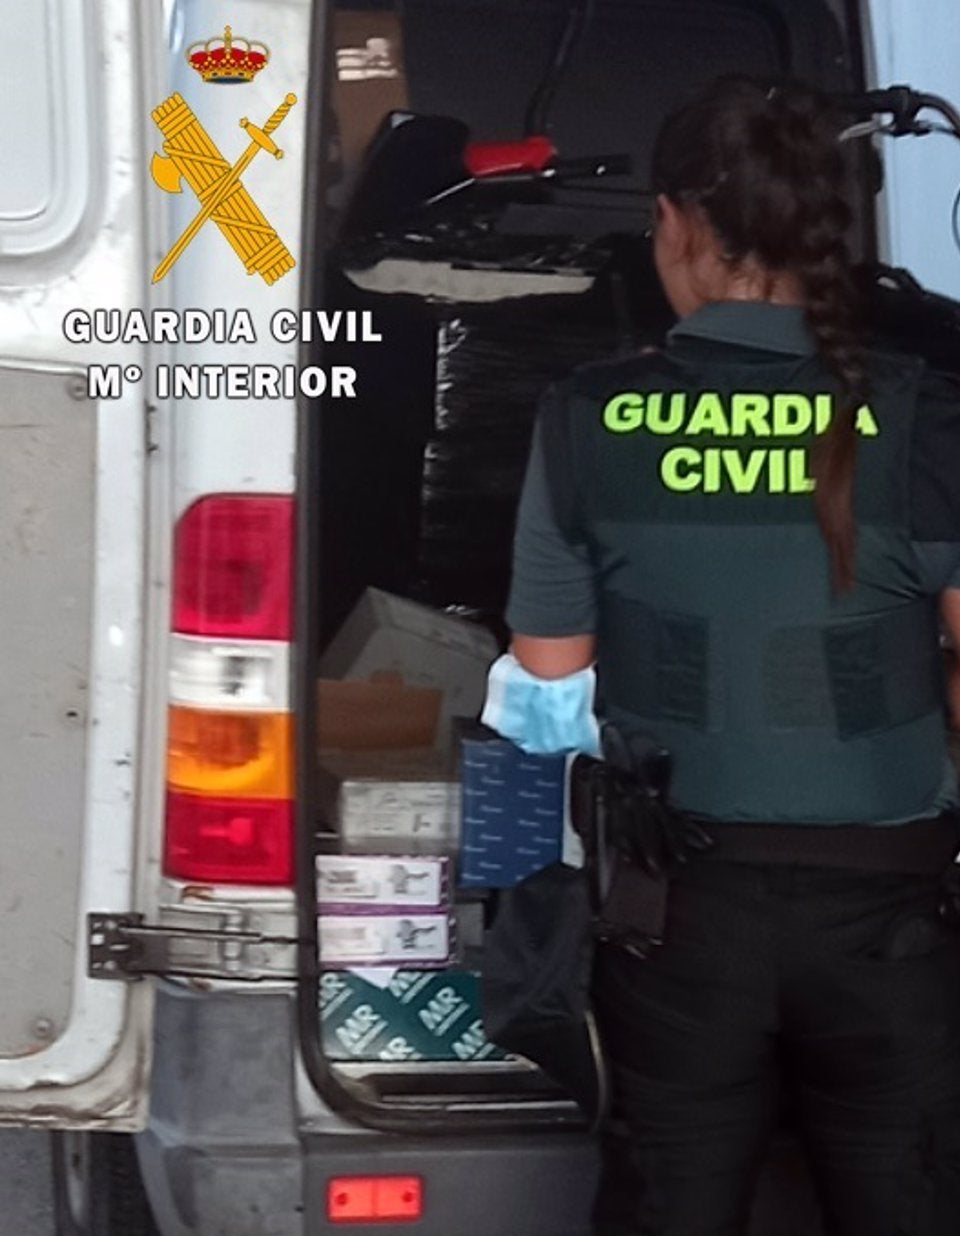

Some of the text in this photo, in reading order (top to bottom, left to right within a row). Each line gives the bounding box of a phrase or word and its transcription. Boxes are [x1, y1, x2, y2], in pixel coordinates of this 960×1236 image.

[603, 392, 879, 437] GUARDIA
[660, 446, 817, 494] CIVIL
[335, 1004, 382, 1049] MR
[418, 986, 464, 1031] MR
